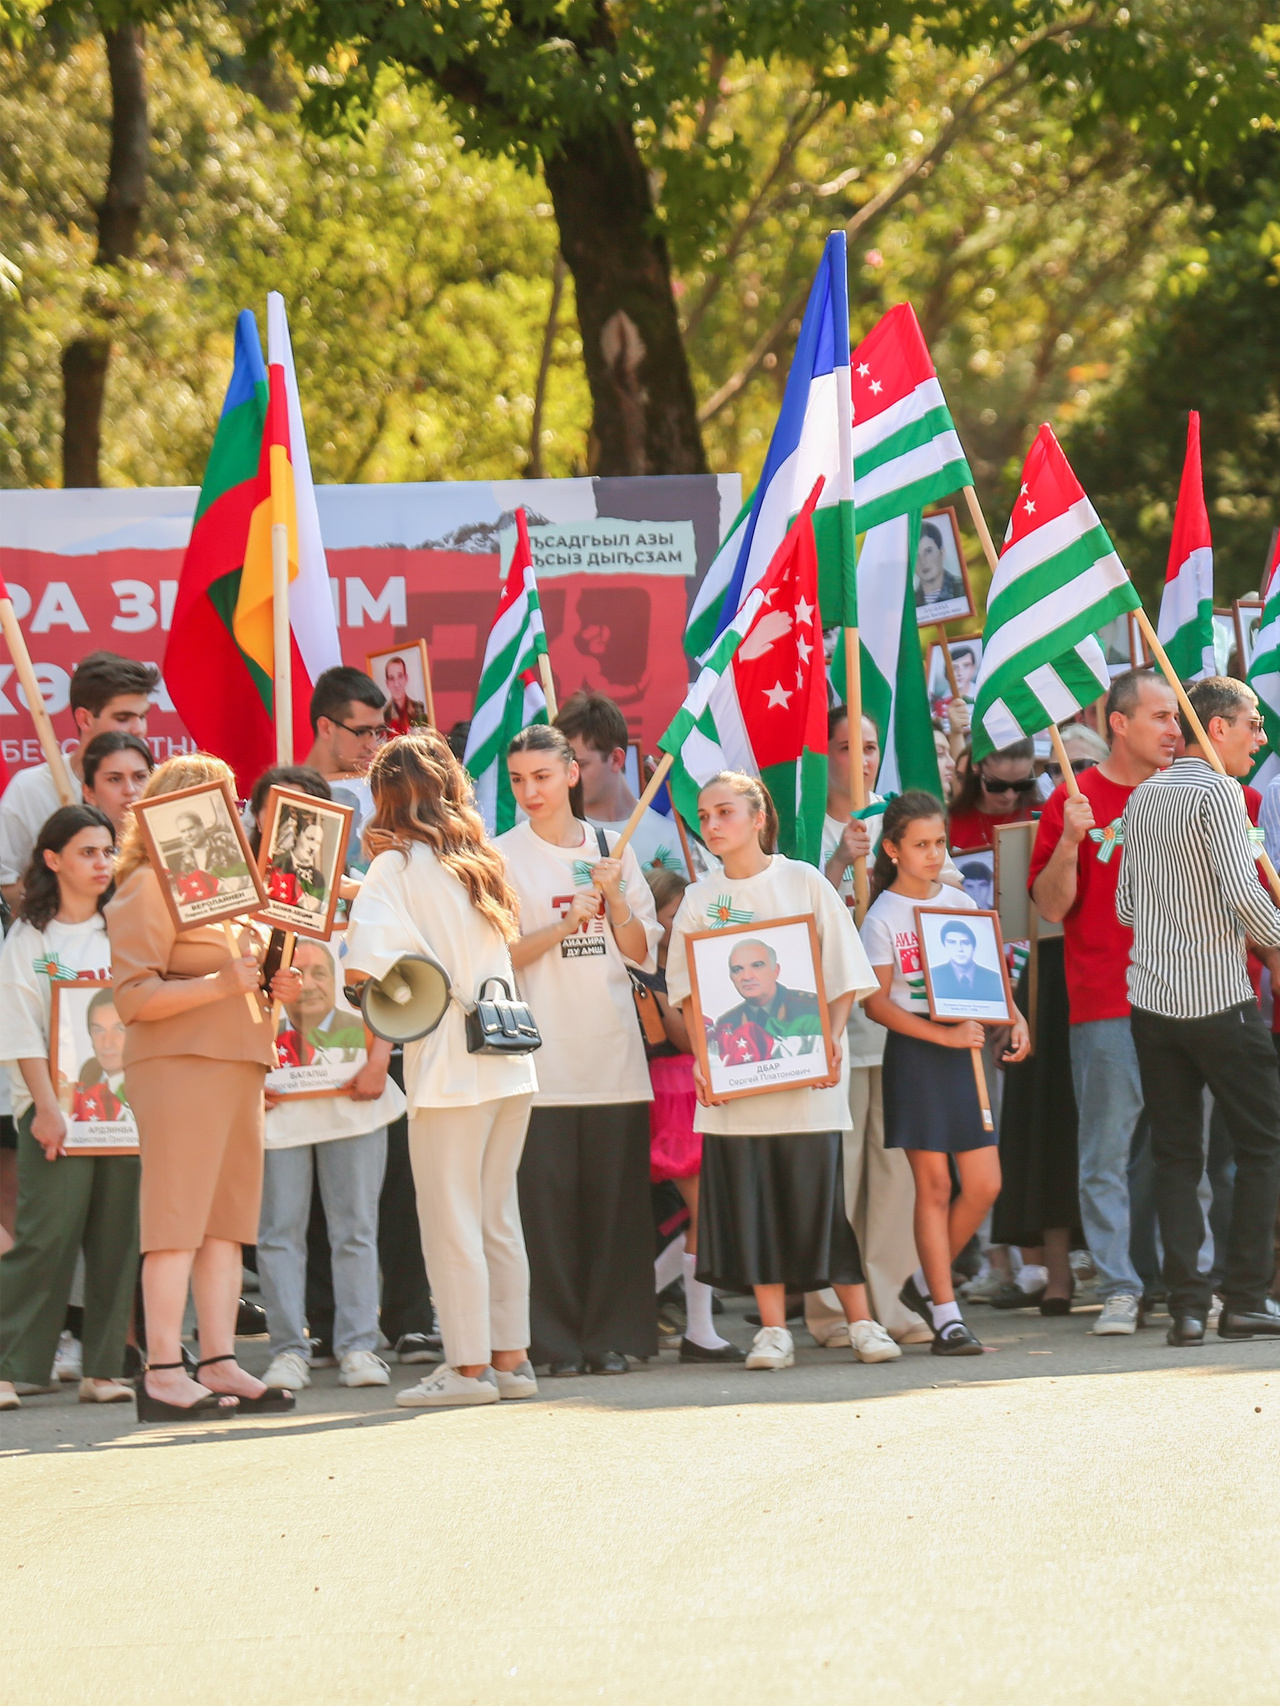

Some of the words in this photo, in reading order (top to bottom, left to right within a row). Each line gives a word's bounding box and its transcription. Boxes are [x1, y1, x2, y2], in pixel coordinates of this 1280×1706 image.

[635, 533, 673, 547] АЗЫ
[562, 936, 605, 948] АИААИРА
[566, 947, 580, 957] ДУ
[581, 945, 604, 955] АМШ
[756, 1062, 780, 1073] ДБАР
[728, 1075, 759, 1087] Сергей
[760, 1068, 811, 1082] Платонович
